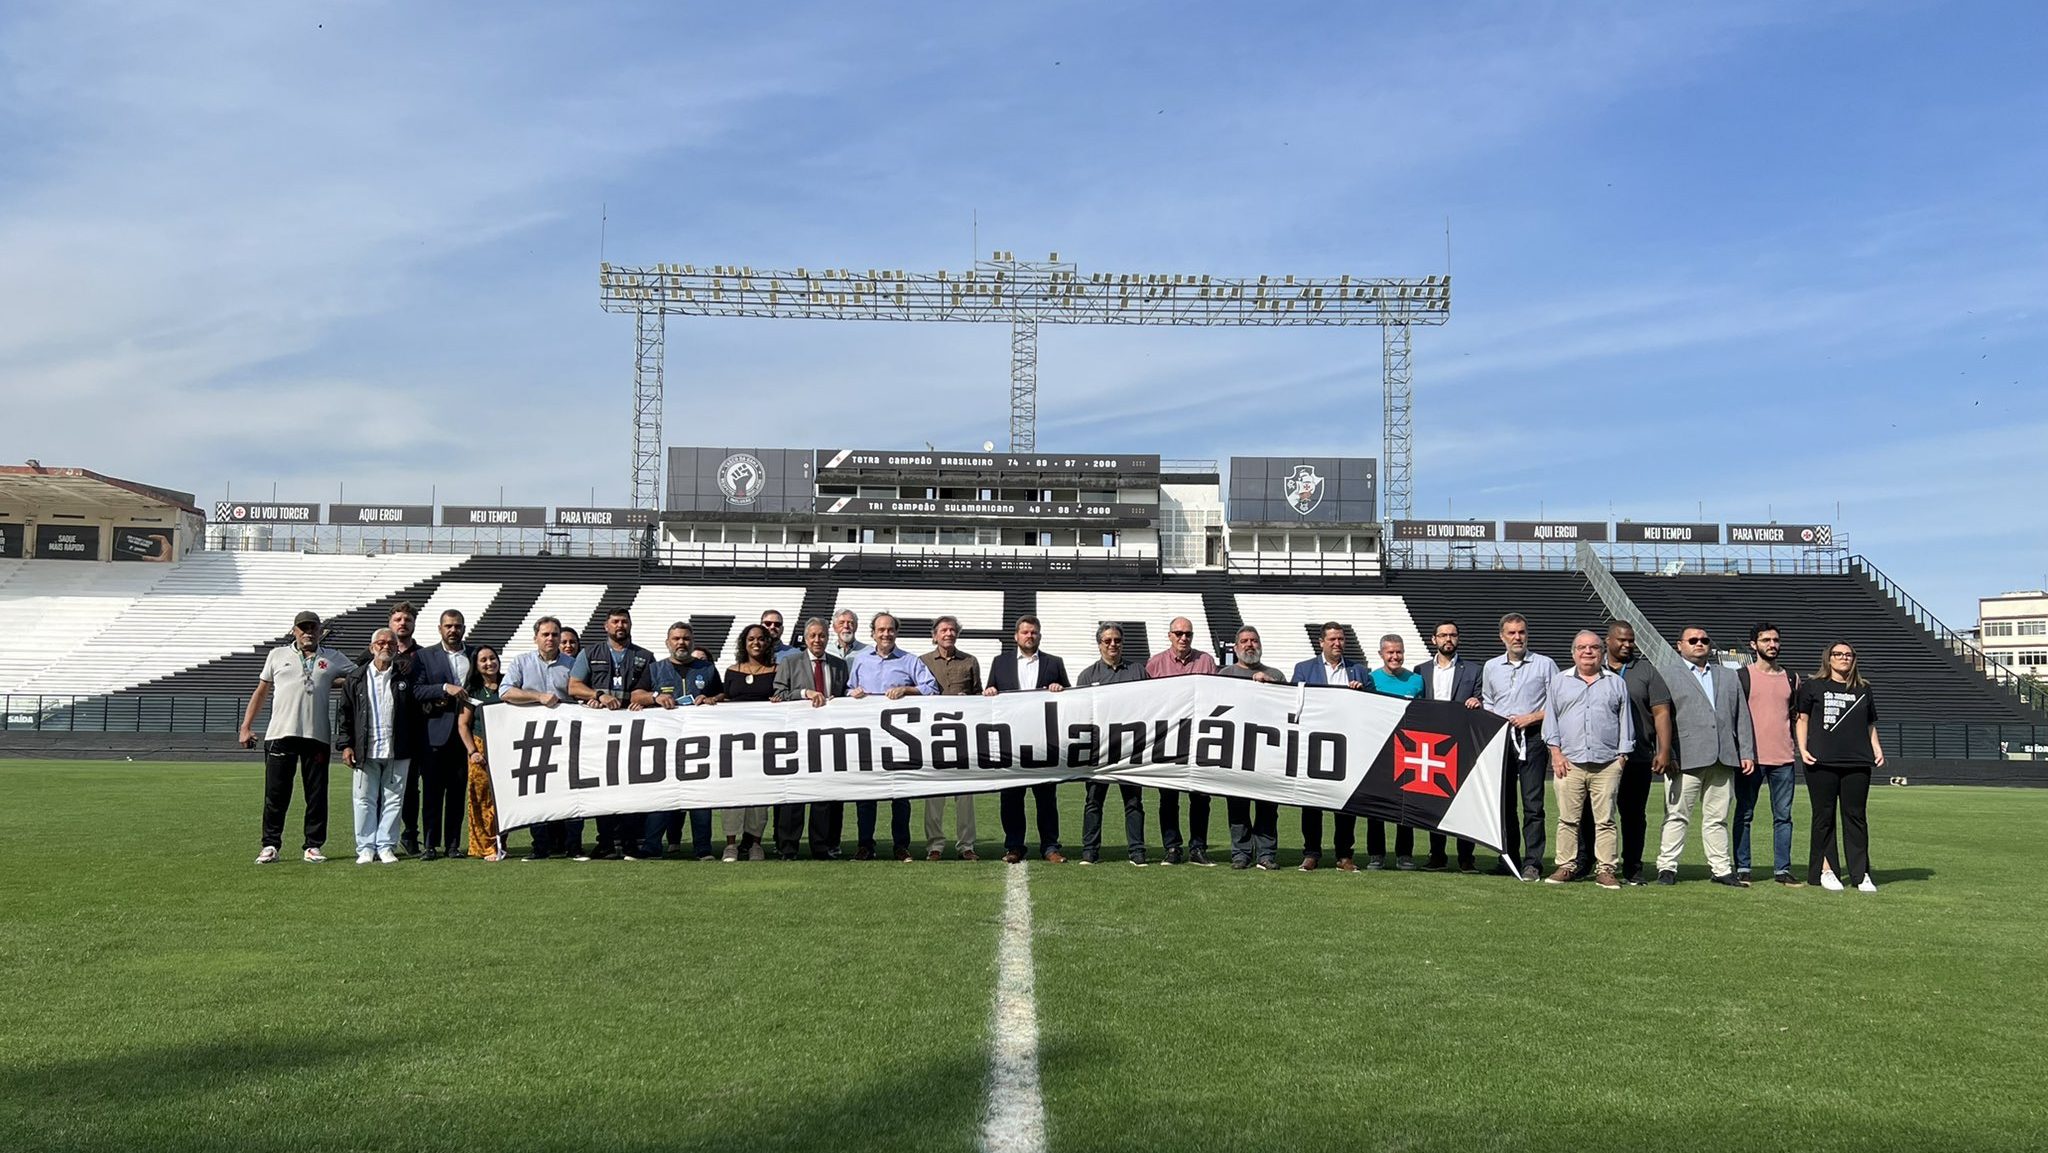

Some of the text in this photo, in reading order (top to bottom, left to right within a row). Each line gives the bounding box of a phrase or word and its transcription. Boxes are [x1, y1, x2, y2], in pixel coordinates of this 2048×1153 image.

[250, 506, 309, 521] EU VOU TORCER
[359, 508, 402, 522] AQUI ERGUI
[470, 510, 517, 524] MEU TEMPLO
[561, 511, 612, 525] PARA VENCER
[1427, 524, 1486, 538] EU VOU TORCER
[1534, 525, 1578, 539] AQUI ERGUI
[1644, 526, 1692, 540] MEU TEMPLO
[1733, 528, 1783, 542] PARA VENCER
[7, 713, 34, 723] SAÍDA
[511, 701, 1346, 796] #LiberemSãoJanuário
